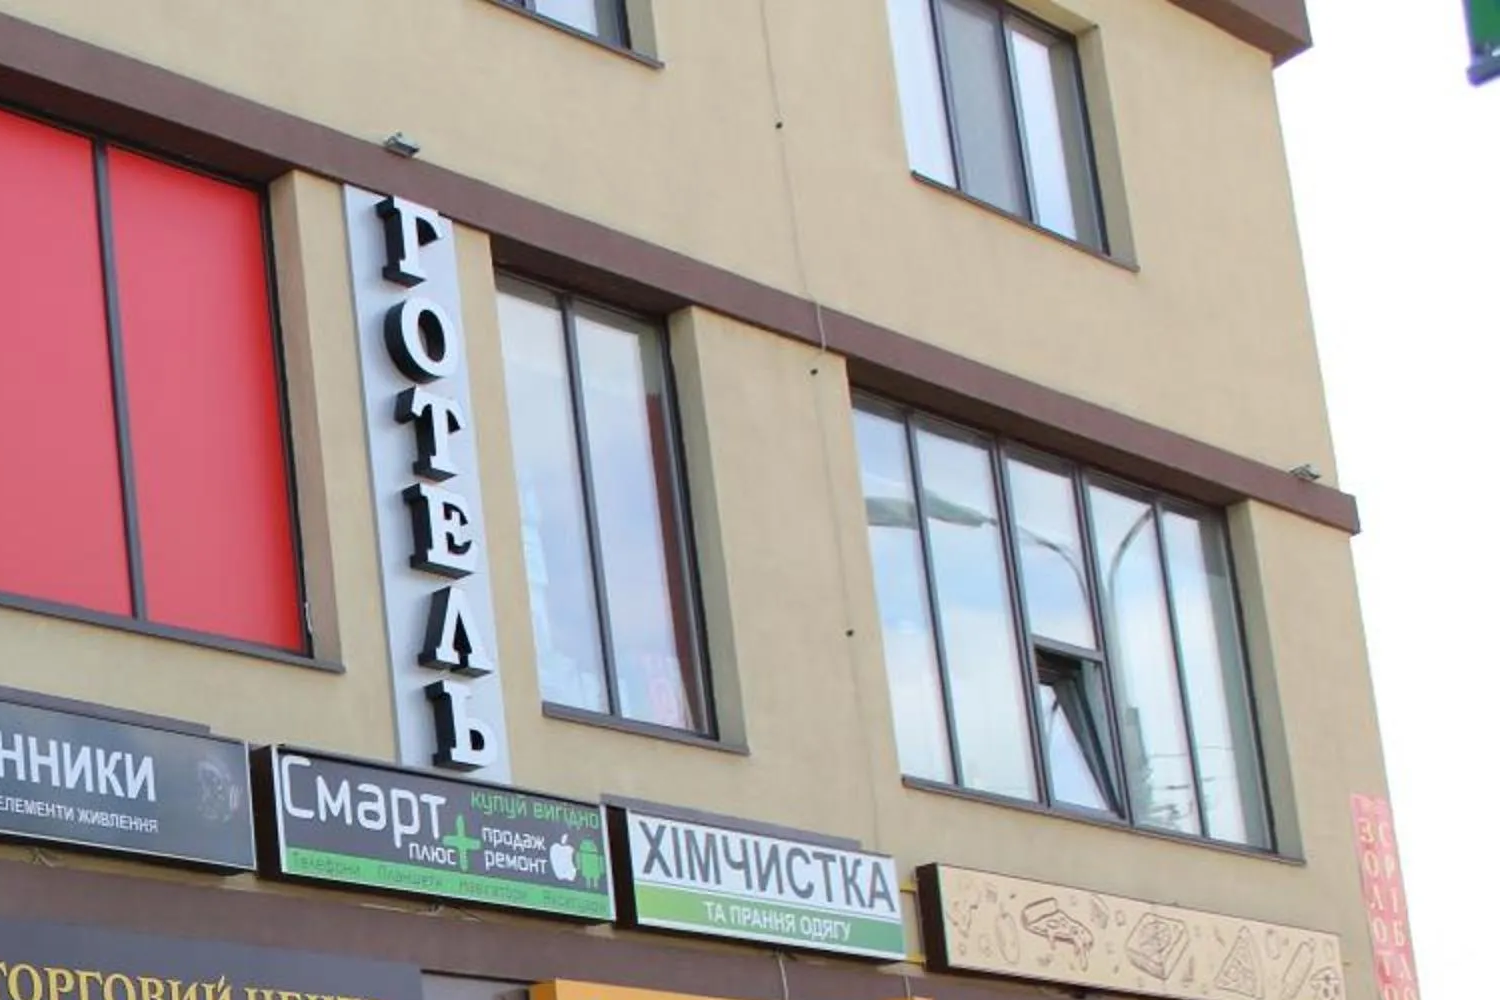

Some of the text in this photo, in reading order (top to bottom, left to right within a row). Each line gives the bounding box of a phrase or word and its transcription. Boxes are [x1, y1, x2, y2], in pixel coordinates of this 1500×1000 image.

[376, 195, 495, 773] ГОТЕЛЬ
[77, 807, 160, 834] ЖИВЛЕННЯ
[280, 755, 447, 848] Смарт
[482, 827, 547, 853] продаж
[483, 849, 548, 875] ремонт
[639, 820, 896, 912] ХІМЧИСТКА
[704, 901, 852, 942] ТА ПРАННЯ ОДЯГУ
